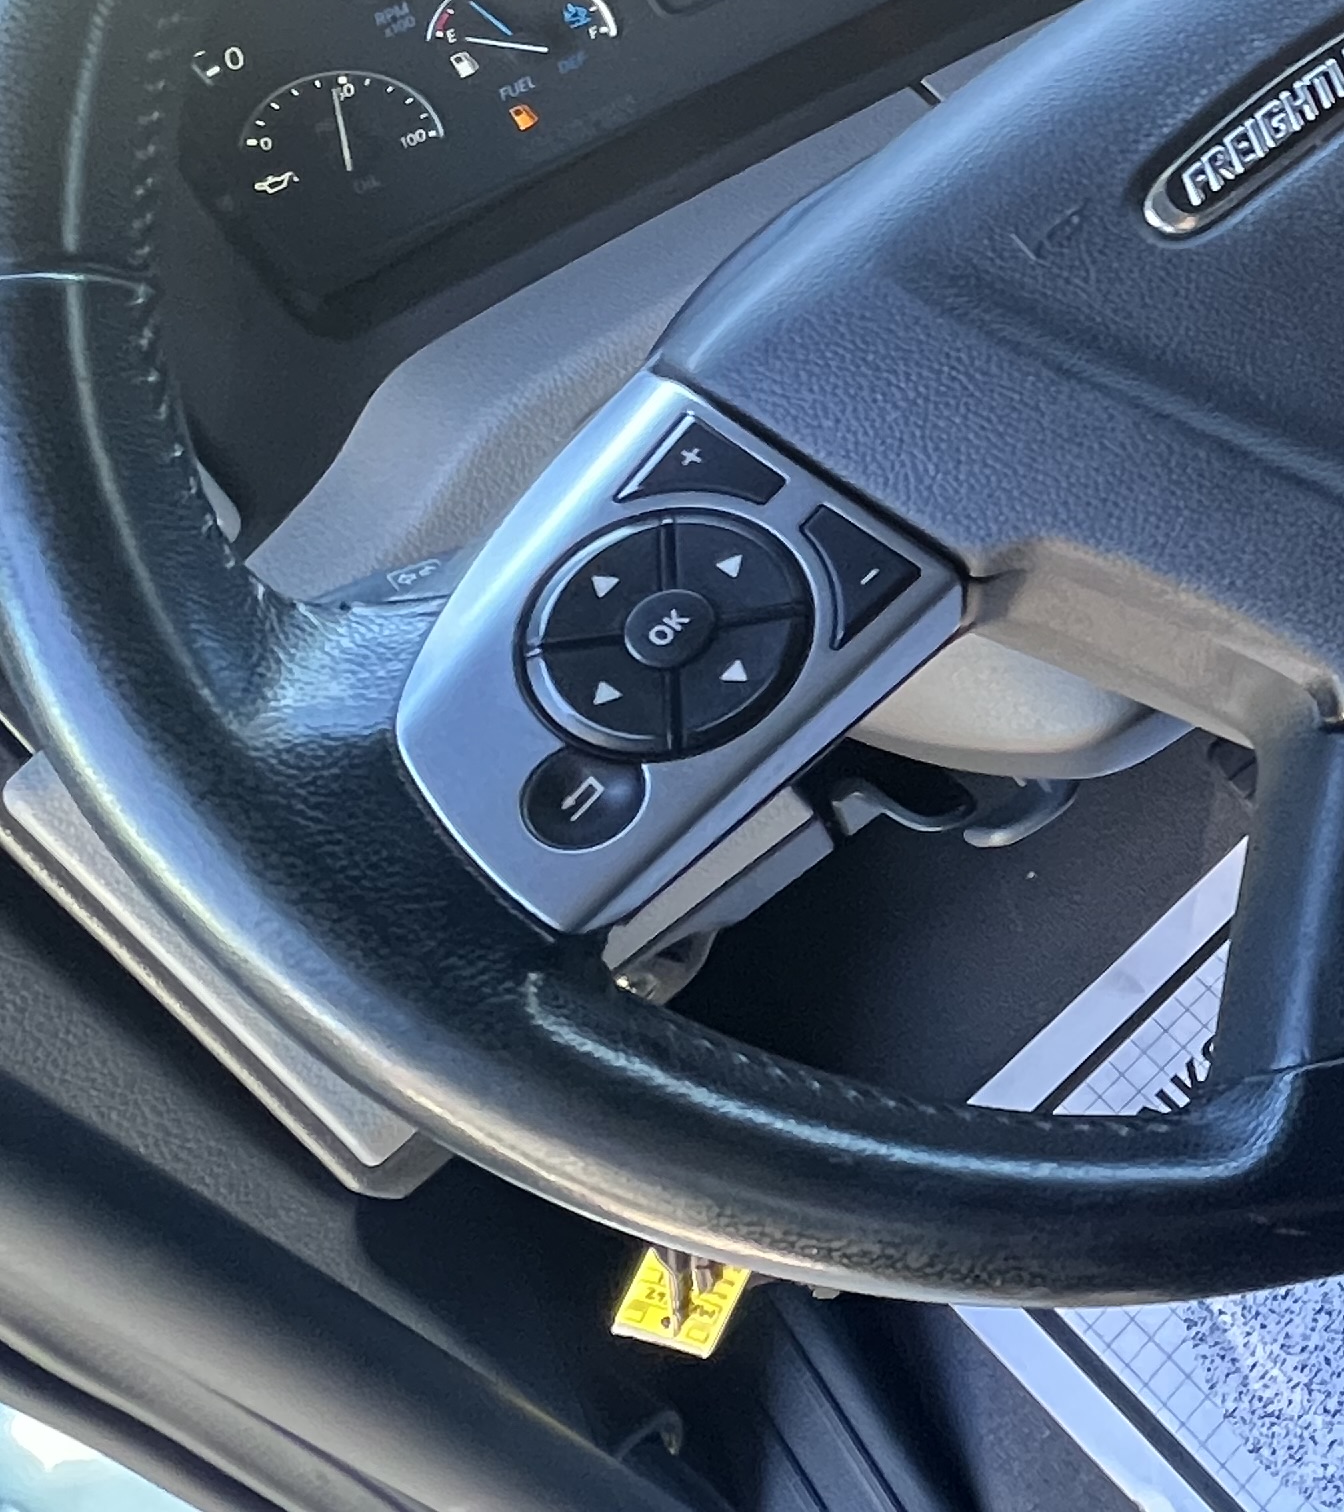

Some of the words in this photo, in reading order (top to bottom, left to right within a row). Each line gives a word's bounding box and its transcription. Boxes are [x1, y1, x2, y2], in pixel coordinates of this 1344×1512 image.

[445, 29, 457, 44] E
[588, 25, 600, 40] F
[224, 46, 244, 70] 0
[500, 76, 536, 100] FUEL
[260, 136, 273, 151] 0
[400, 128, 427, 149] 100
[649, 609, 691, 646] OK
